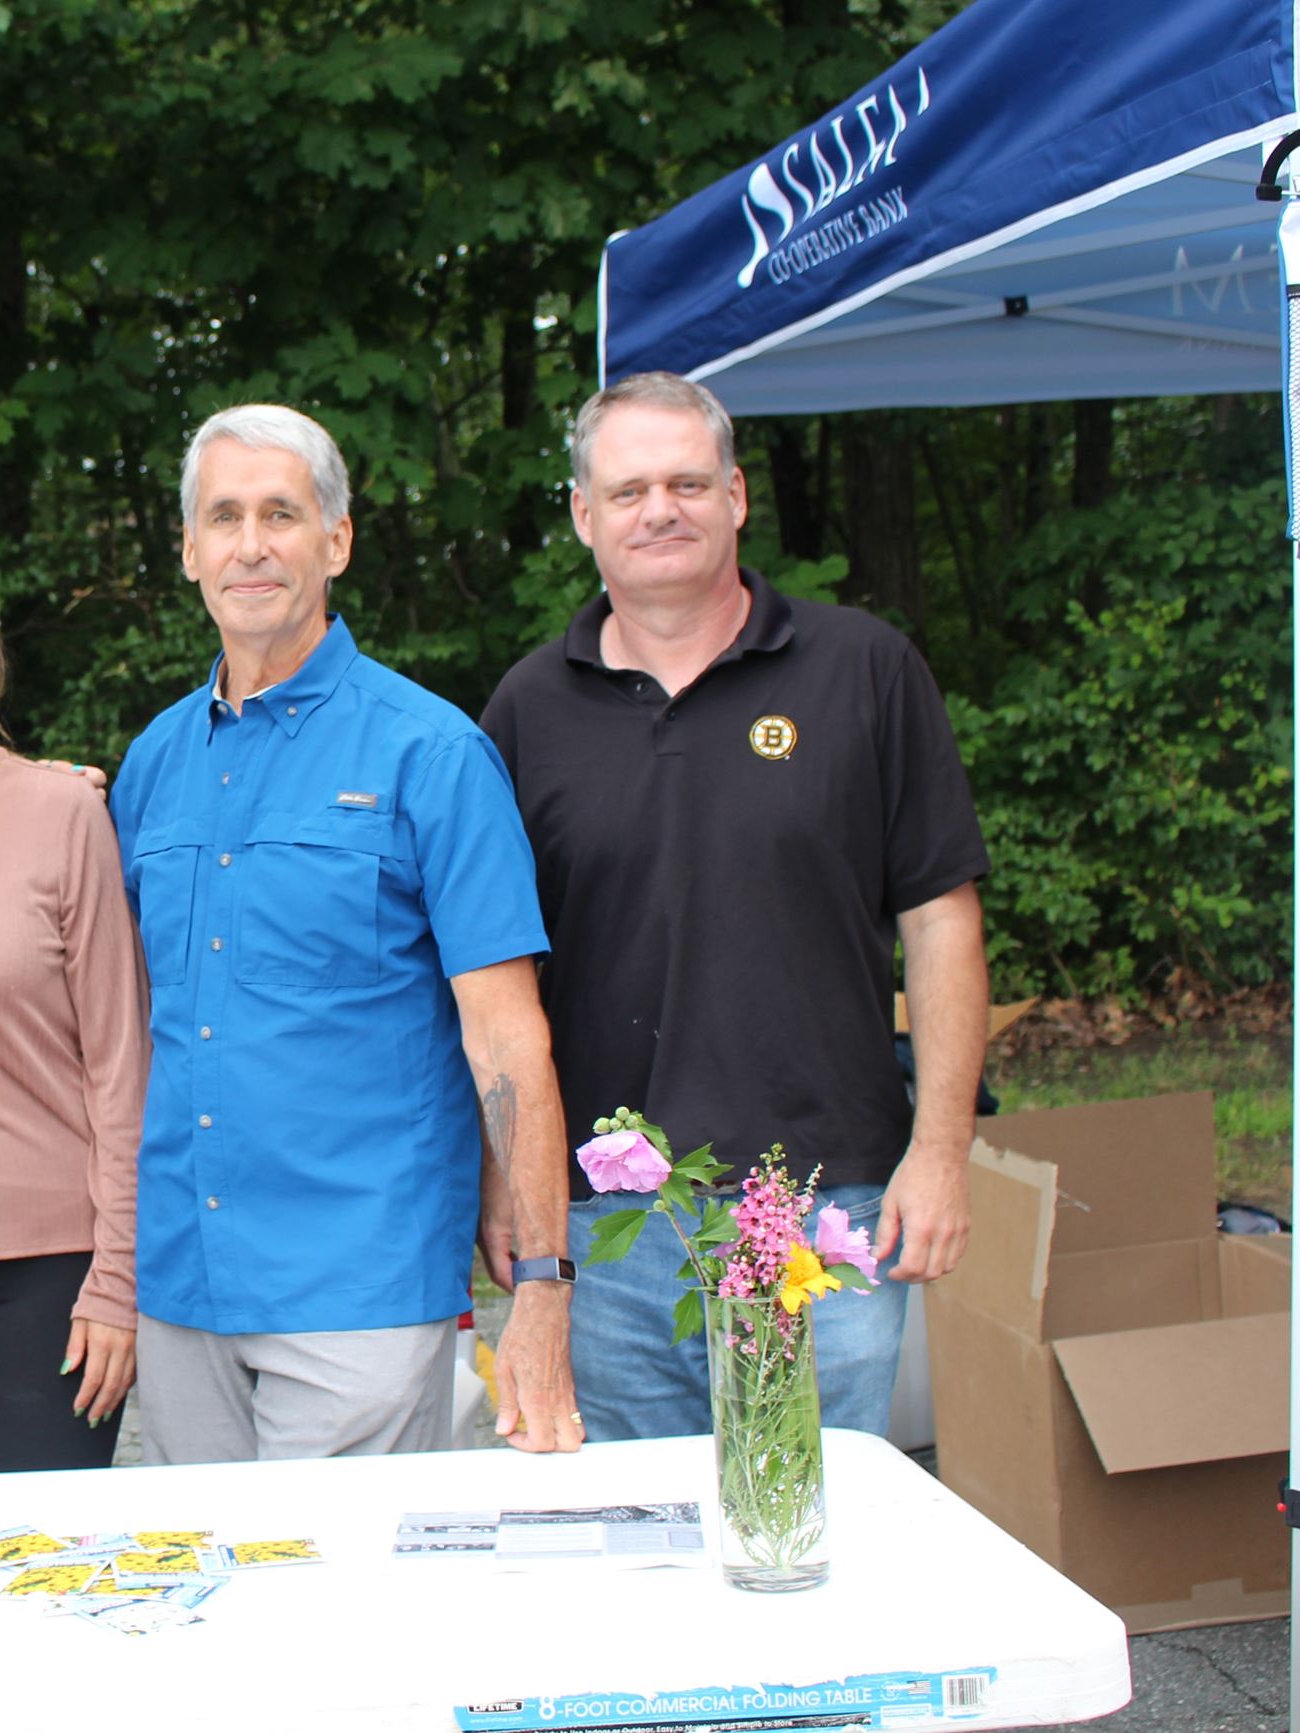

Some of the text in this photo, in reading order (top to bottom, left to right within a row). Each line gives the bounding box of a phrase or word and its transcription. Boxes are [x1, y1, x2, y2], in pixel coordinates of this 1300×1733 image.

[768, 185, 908, 284] CO-OPERATIVE BANK
[473, 1702, 518, 1712] LIFETIME
[539, 1696, 611, 1720] 8-FOOT
[616, 1695, 739, 1715] COMMERCIAL
[743, 1690, 820, 1709] FOLDING
[825, 1687, 872, 1704] TABLE
